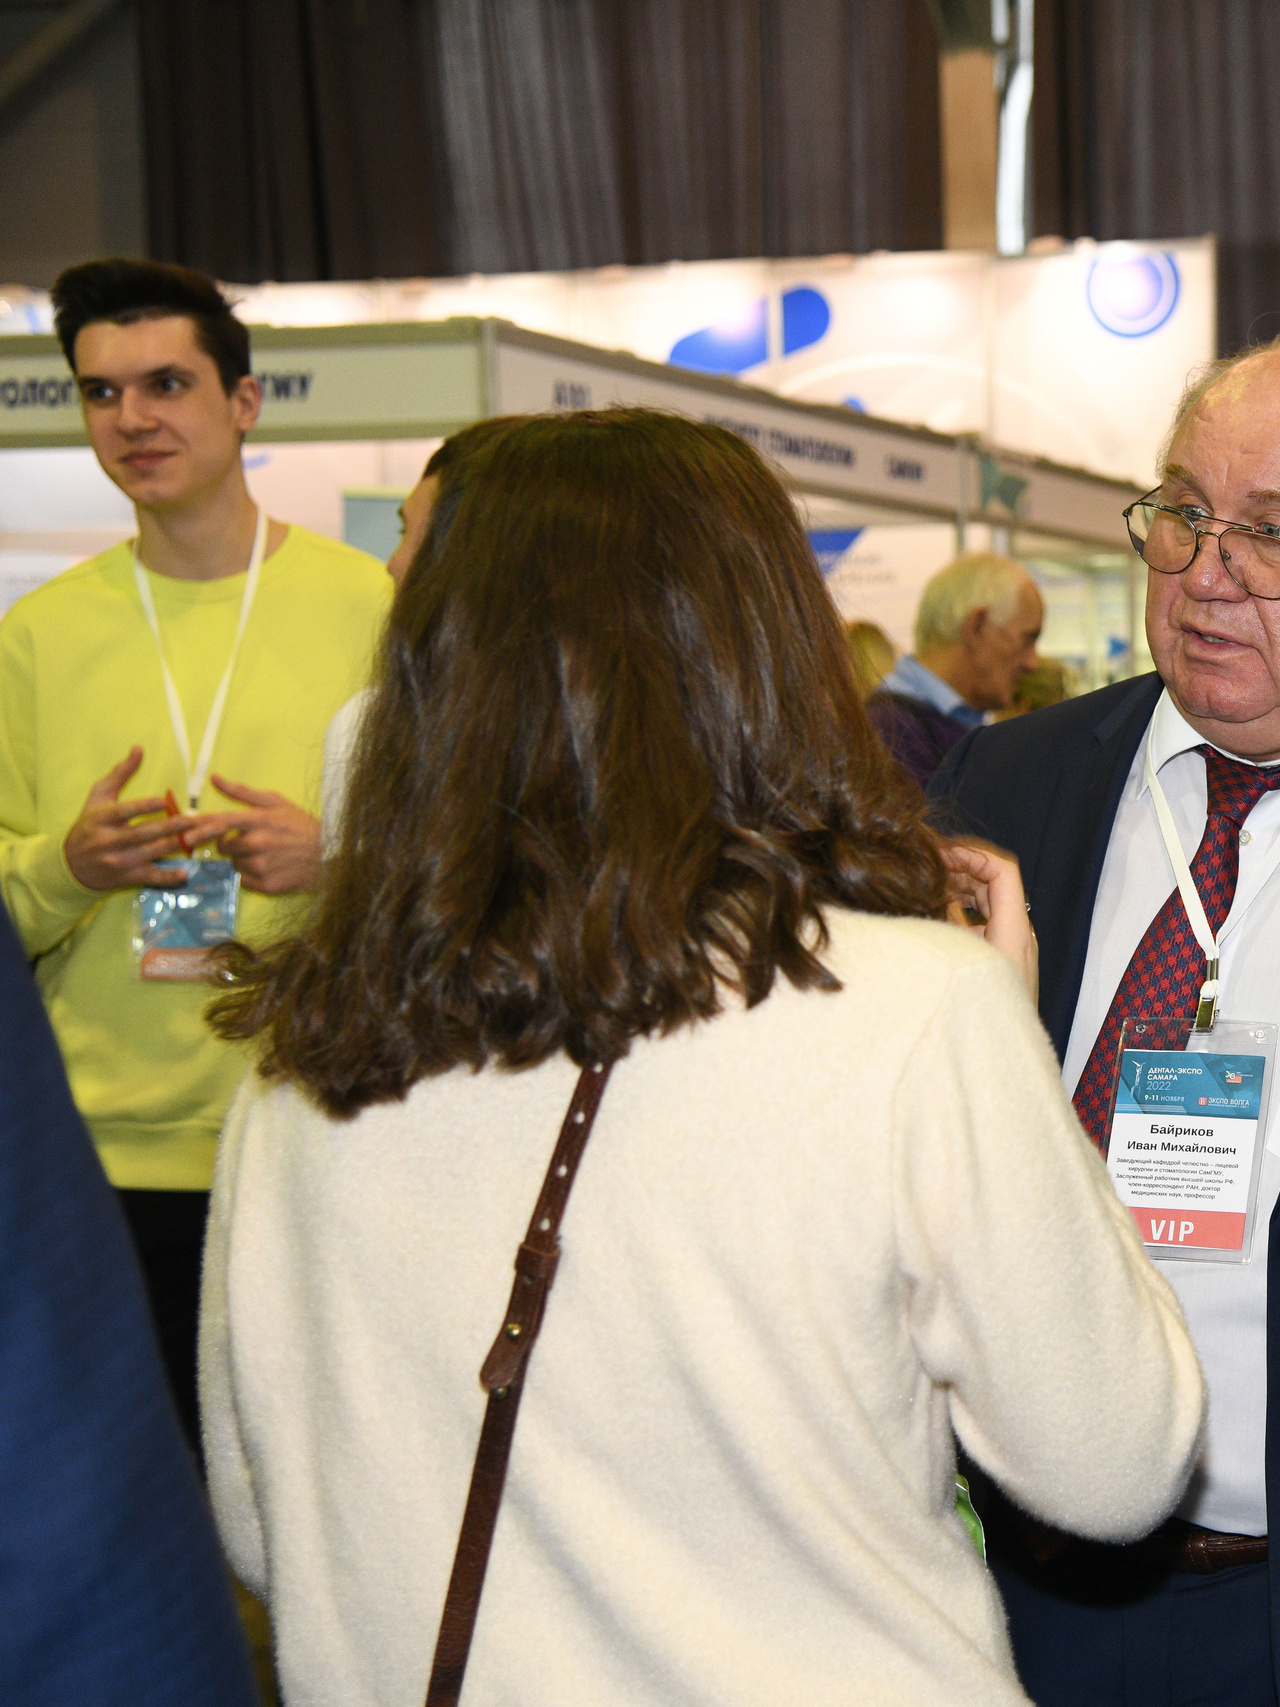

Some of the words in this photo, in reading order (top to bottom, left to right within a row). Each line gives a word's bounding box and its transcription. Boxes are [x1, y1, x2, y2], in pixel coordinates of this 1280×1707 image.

[1147, 1067, 1203, 1075] ДЕНТАЛ-ЭКСПО
[1146, 1080, 1172, 1091] 2022
[1150, 1124, 1214, 1137] Байриков
[1127, 1140, 1157, 1151] Иван
[1160, 1142, 1237, 1155] Михайлович
[1150, 1219, 1195, 1242] VIP
